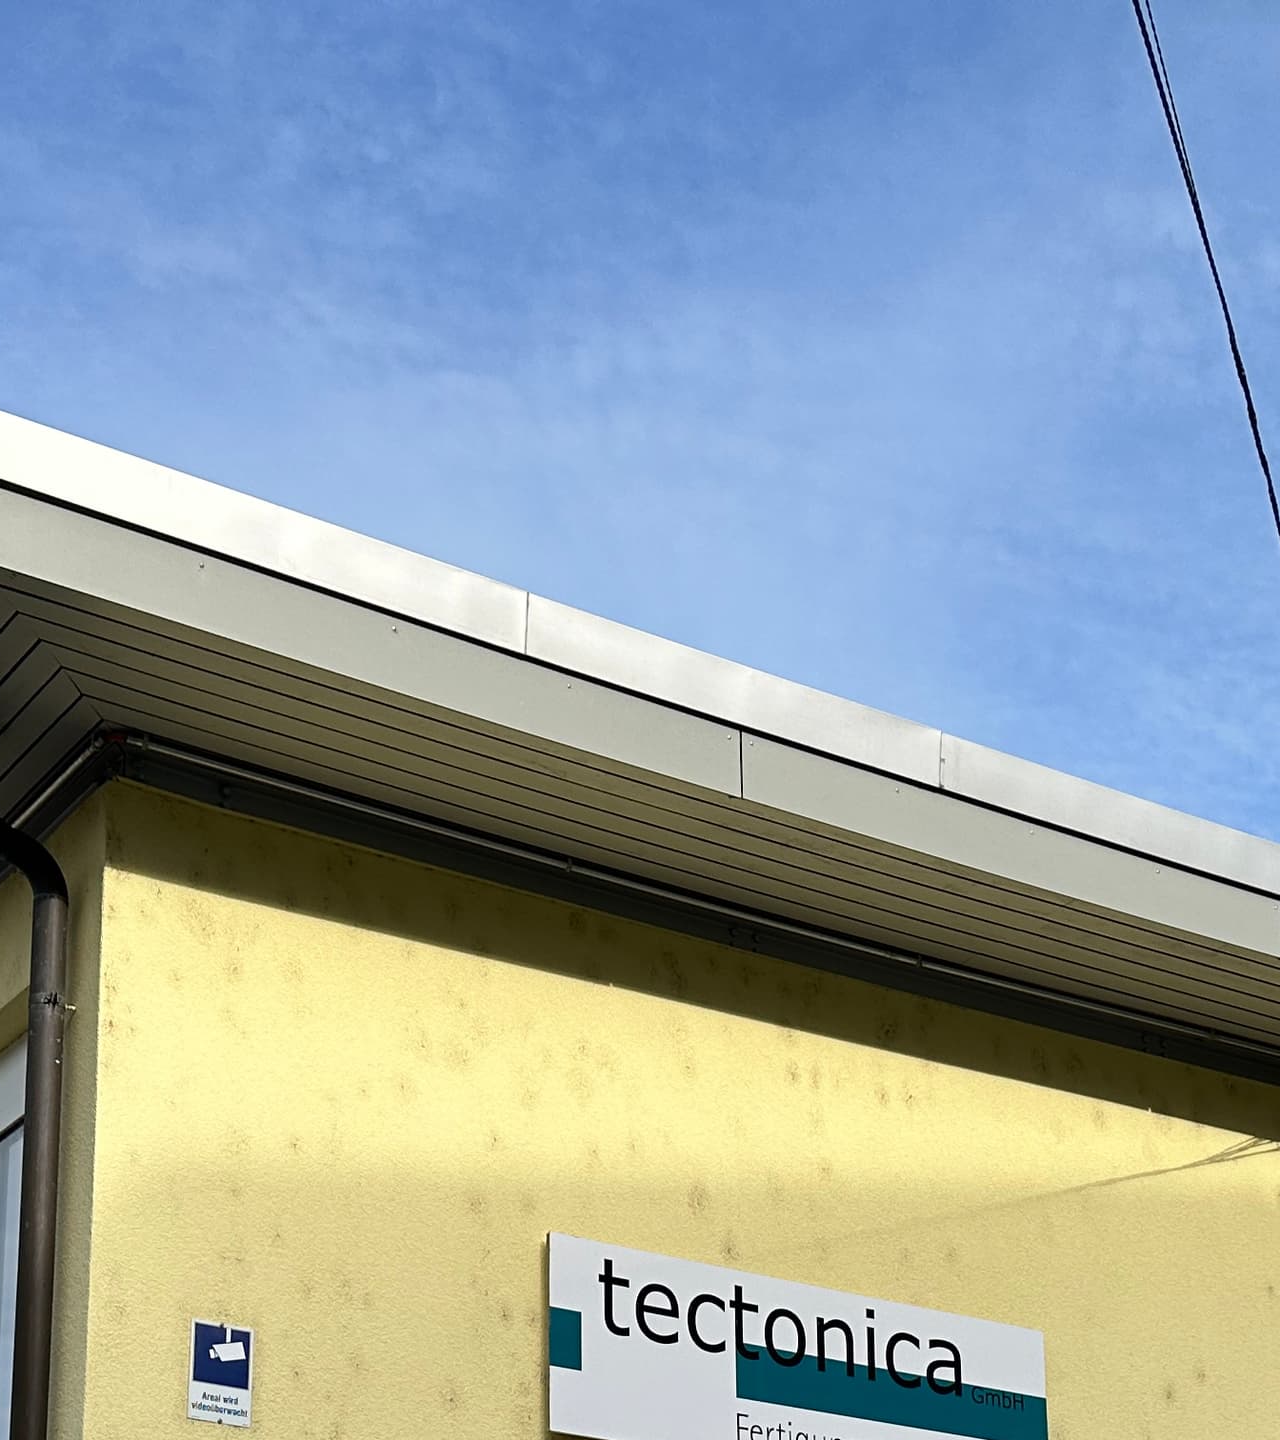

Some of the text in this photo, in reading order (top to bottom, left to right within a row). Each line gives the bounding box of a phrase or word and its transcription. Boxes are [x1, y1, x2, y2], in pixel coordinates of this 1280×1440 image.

[597, 1258, 1025, 1413] tectonica GmbH
[223, 1395, 239, 1405] wird
